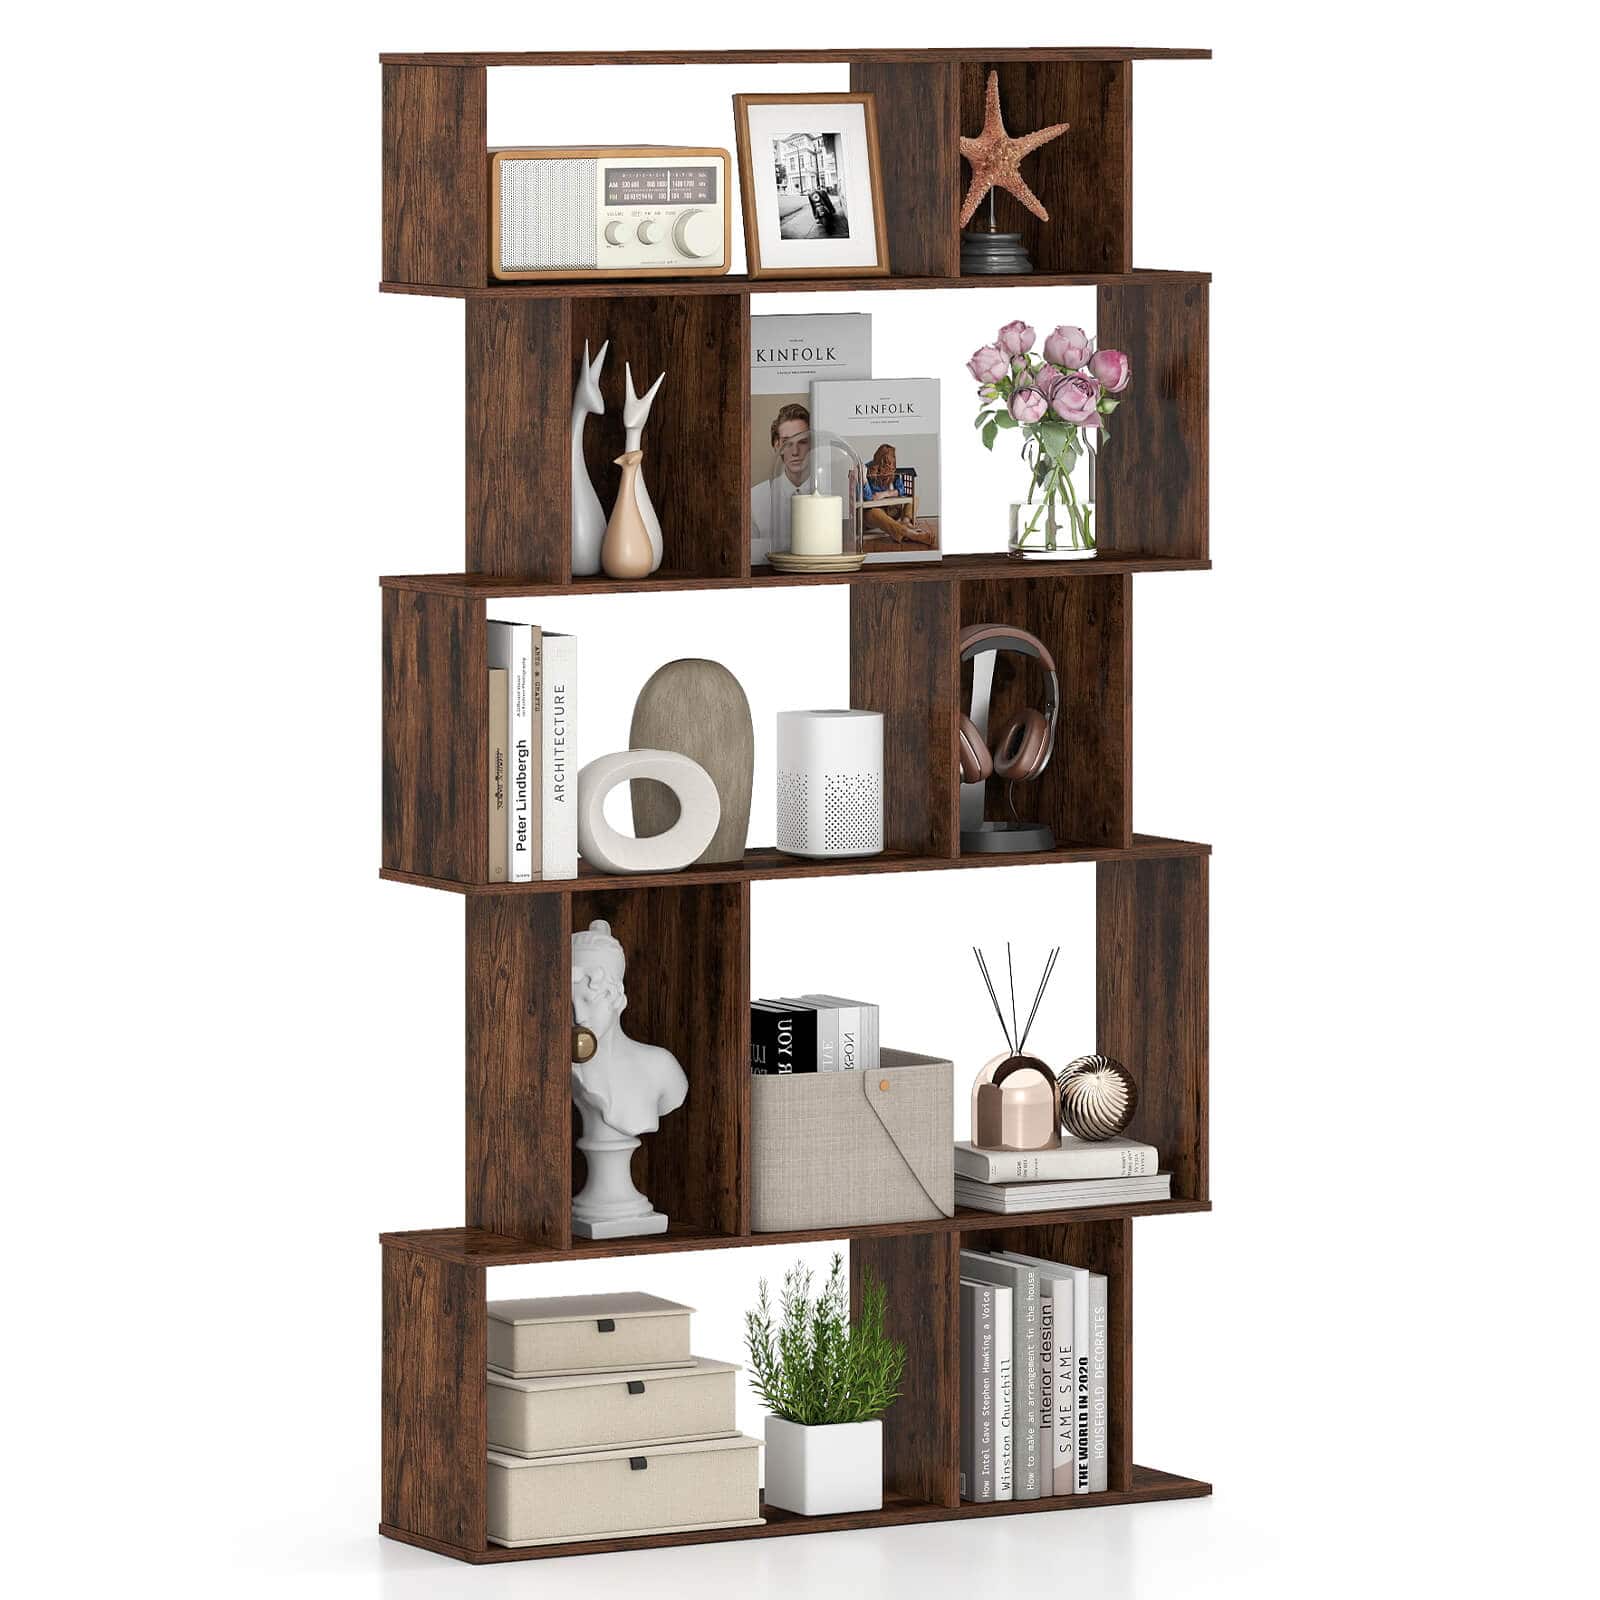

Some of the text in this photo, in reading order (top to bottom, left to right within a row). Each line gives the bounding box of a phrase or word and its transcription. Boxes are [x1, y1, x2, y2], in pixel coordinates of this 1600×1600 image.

[756, 348, 836, 362] KINFOLK
[855, 403, 914, 415] KINFOLK
[554, 684, 564, 802] ARCHITECTURE
[516, 740, 529, 851] Peter Lindbergh
[982, 1335, 992, 1373] Hawking
[1026, 1328, 1034, 1338] in
[1028, 1345, 1036, 1406] arrangement
[1040, 1304, 1053, 1428] Interior design
[1095, 1306, 1104, 1459] HOUSEHOLD DECORATES
[982, 1378, 992, 1416] Stephen
[1001, 1360, 1010, 1490] Winston Churchill
[1028, 1412, 1034, 1422] an
[1060, 1346, 1071, 1452] SAME SAME
[1079, 1357, 1088, 1488] THE WORLD IN 2020
[1028, 1457, 1034, 1467] to
